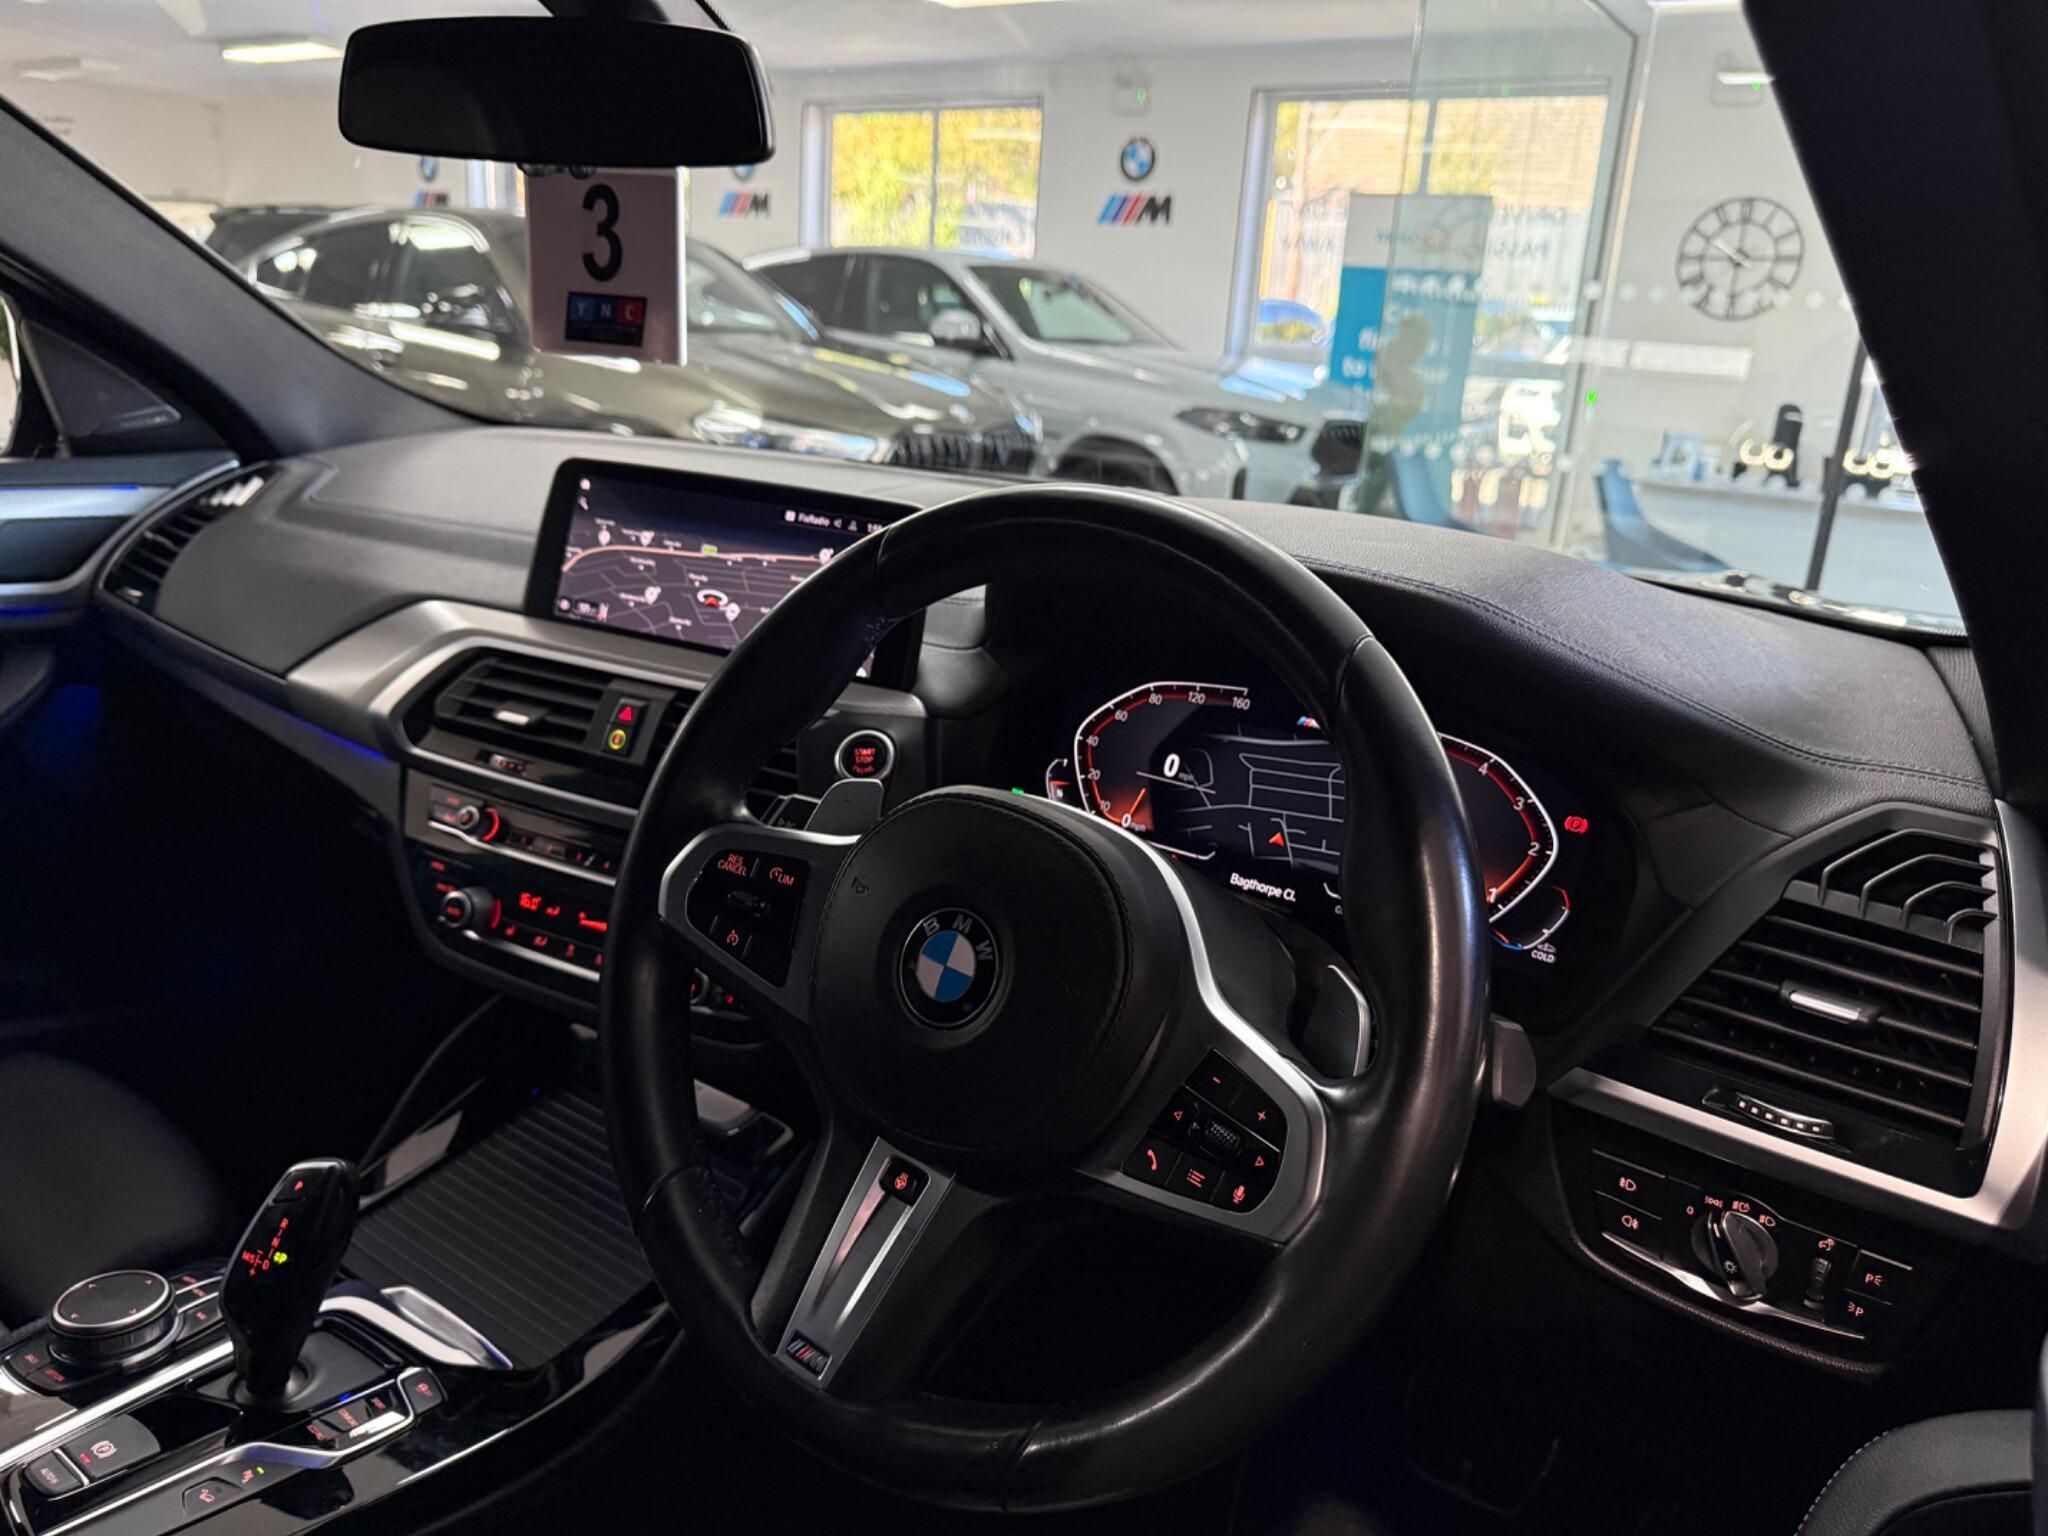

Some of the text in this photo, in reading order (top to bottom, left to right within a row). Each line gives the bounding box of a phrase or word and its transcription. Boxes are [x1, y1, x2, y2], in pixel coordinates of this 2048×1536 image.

[582, 184, 623, 282] 3
[1149, 693, 1162, 705] 80
[1188, 691, 1206, 704] 120
[1232, 697, 1250, 710] 160
[1114, 710, 1128, 722] 60
[1086, 735, 1099, 747] 40
[855, 756, 874, 764] STOP
[1163, 753, 1180, 777] 0
[1088, 768, 1101, 781] 20
[1478, 762, 1489, 776] 4
[1100, 801, 1111, 812] 10
[1513, 796, 1525, 811] 3
[1121, 813, 1146, 832] 0 mph
[1529, 842, 1540, 857] 2
[1230, 872, 1283, 898] Bagthorpe
[1487, 888, 1497, 903] 1
[922, 913, 994, 961] BMW
[1531, 949, 1556, 963] COLD
[280, 1217, 289, 1229] R
[271, 1237, 281, 1248] N
[262, 1259, 270, 1271] D
